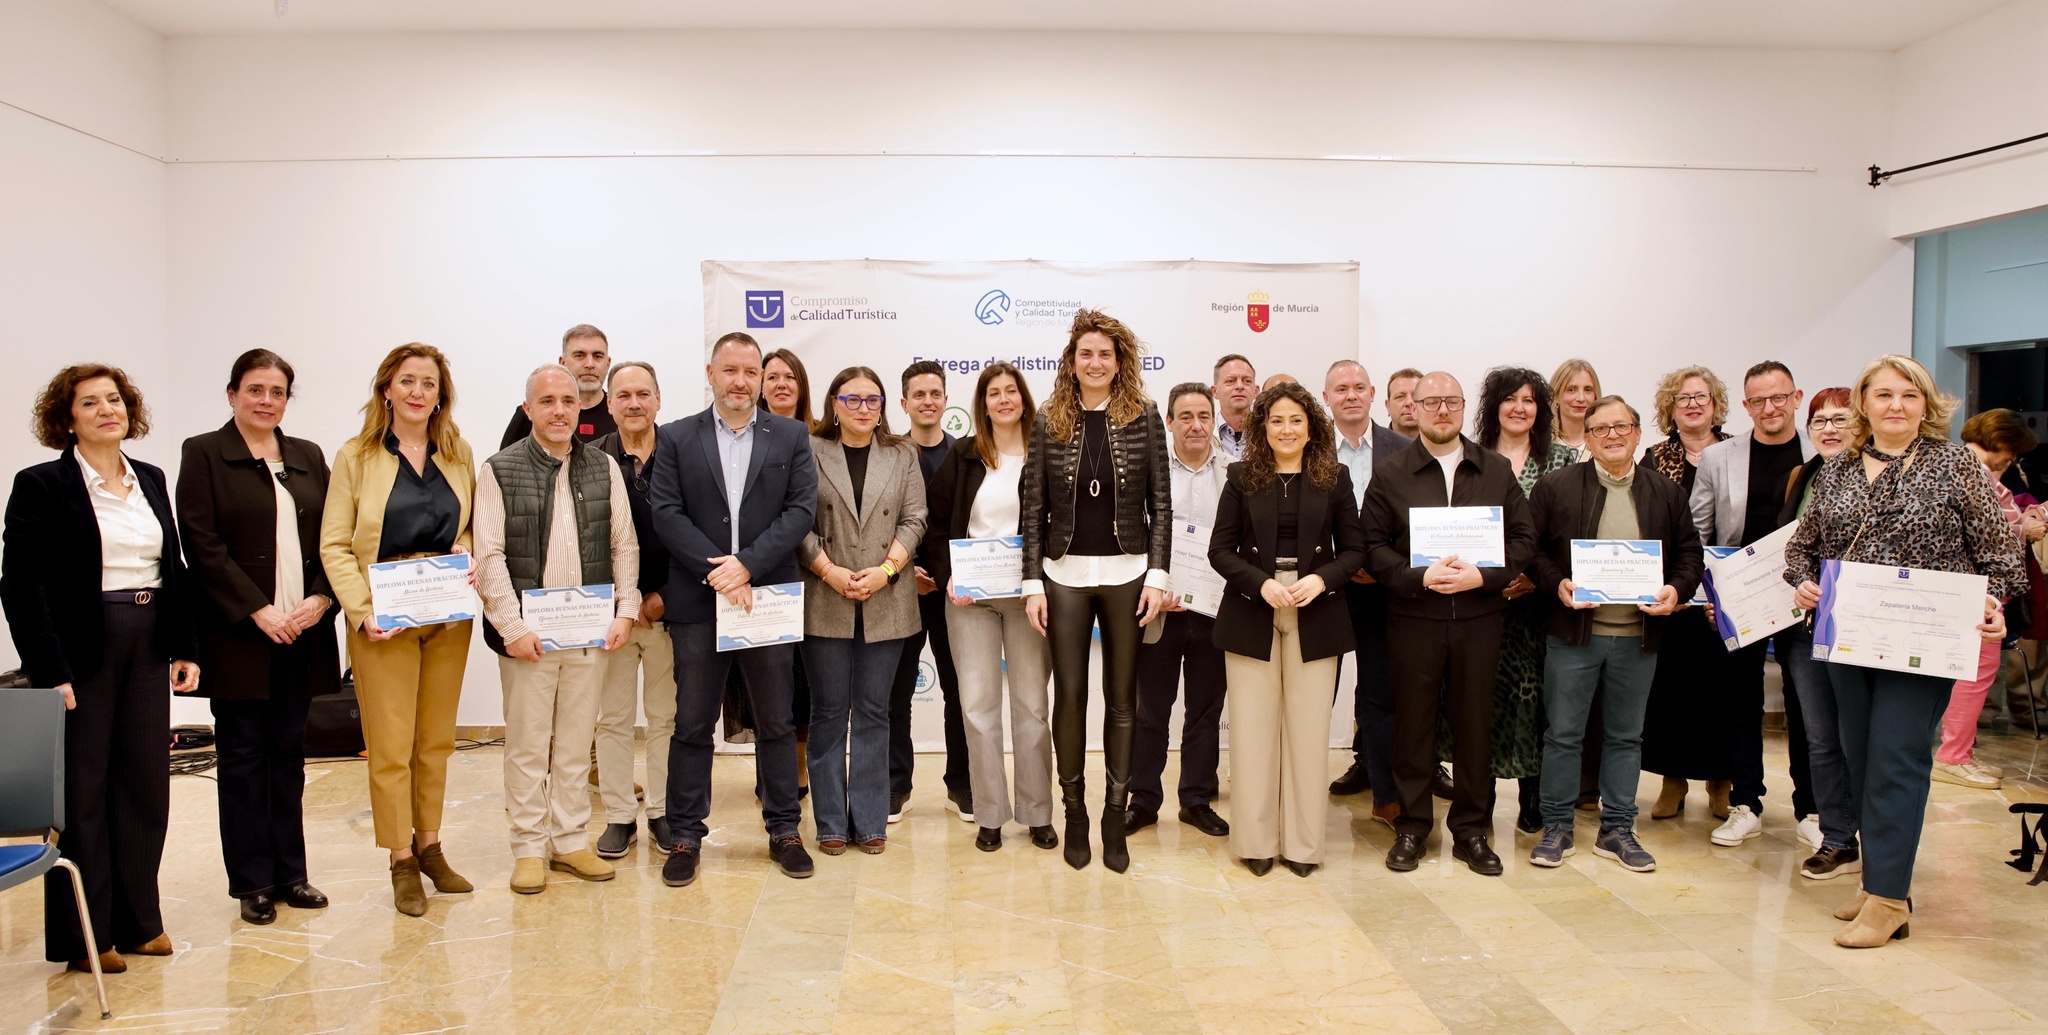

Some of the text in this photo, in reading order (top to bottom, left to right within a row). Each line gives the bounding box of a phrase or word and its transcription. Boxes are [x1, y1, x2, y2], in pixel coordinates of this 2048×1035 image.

[790, 295, 868, 308] Compromiso
[1014, 299, 1082, 308] Competitividad
[1015, 310, 1020, 318] y
[1022, 308, 1055, 317] Calidad
[1211, 302, 1319, 314] Región de Murcia
[1010, 356, 1063, 371] distin
[376, 573, 467, 590] DIPLOMA BUENAS PRÁCTICAS
[1911, 604, 1937, 613] Merche
